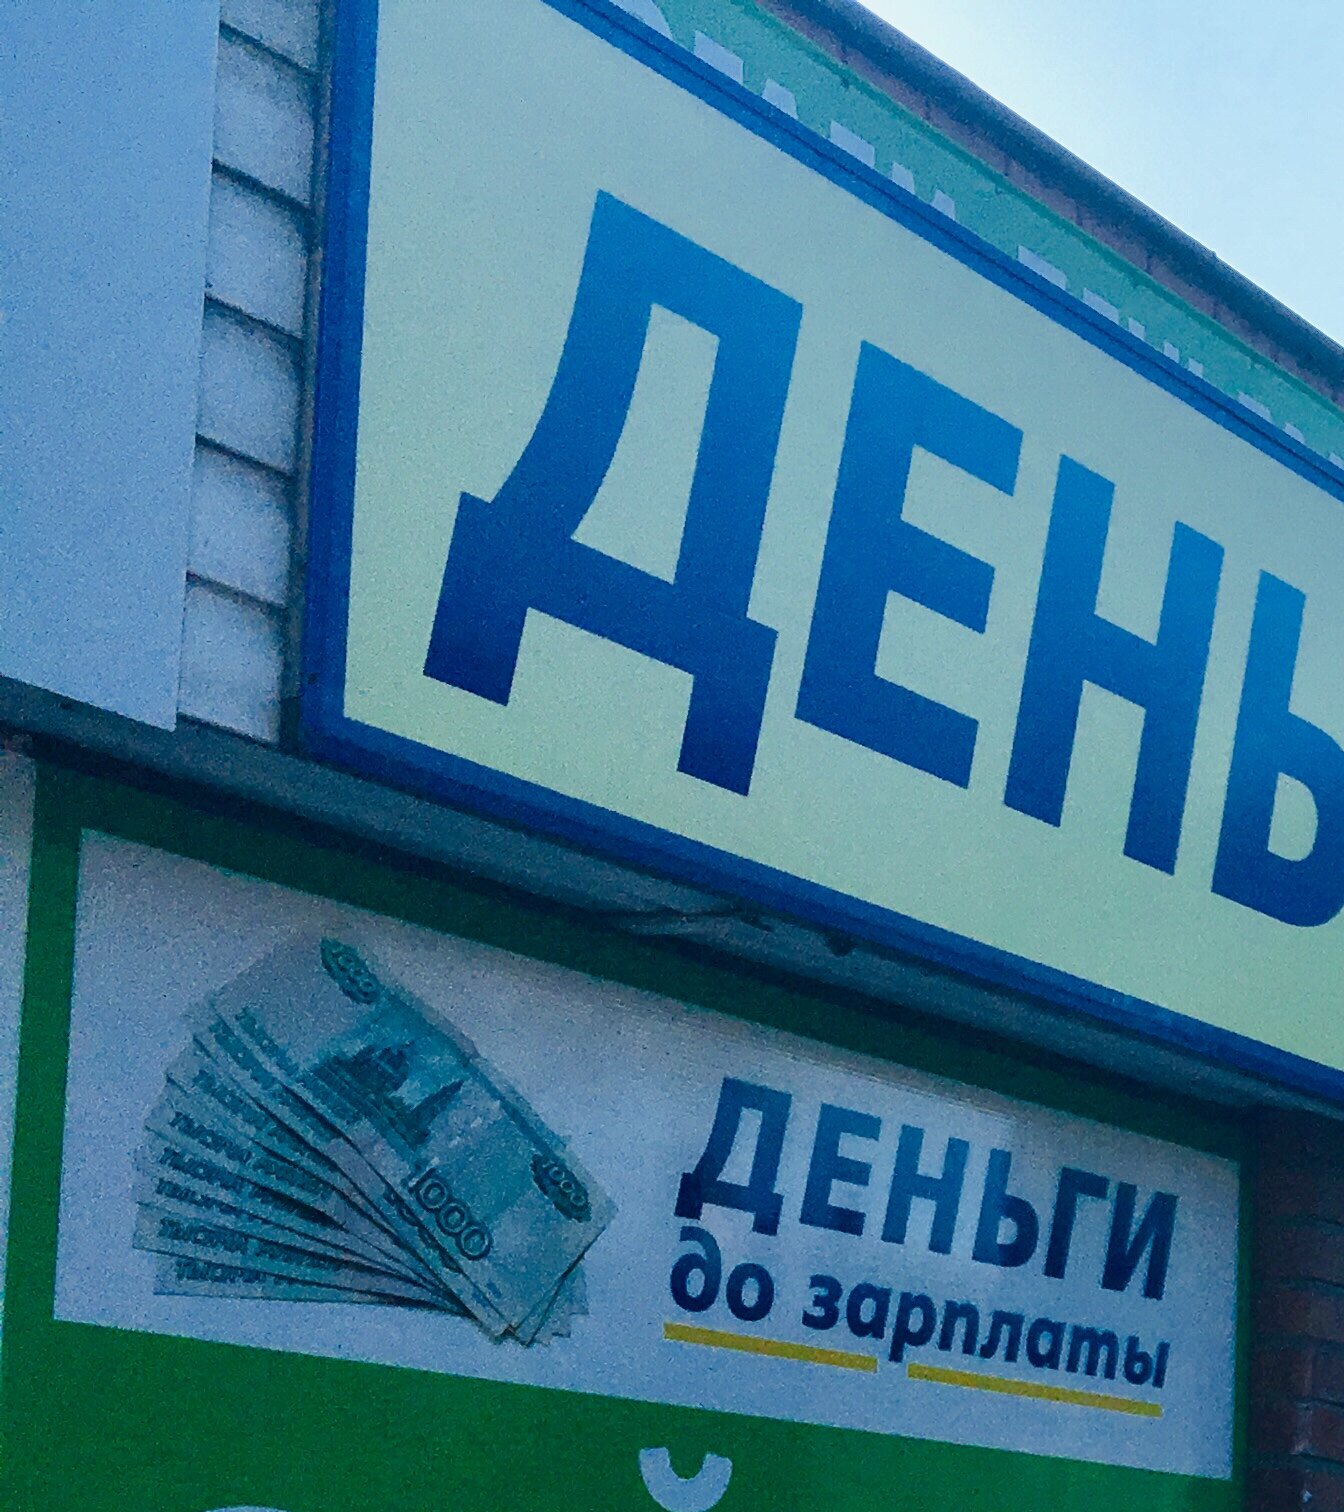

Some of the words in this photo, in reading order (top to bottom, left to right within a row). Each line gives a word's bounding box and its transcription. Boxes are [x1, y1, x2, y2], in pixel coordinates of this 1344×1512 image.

[407, 1167, 493, 1261] 1000
[673, 1076, 1179, 1302] ДЕНЬГИ
[668, 1227, 775, 1323] до
[800, 1262, 1172, 1390] зарплаты
